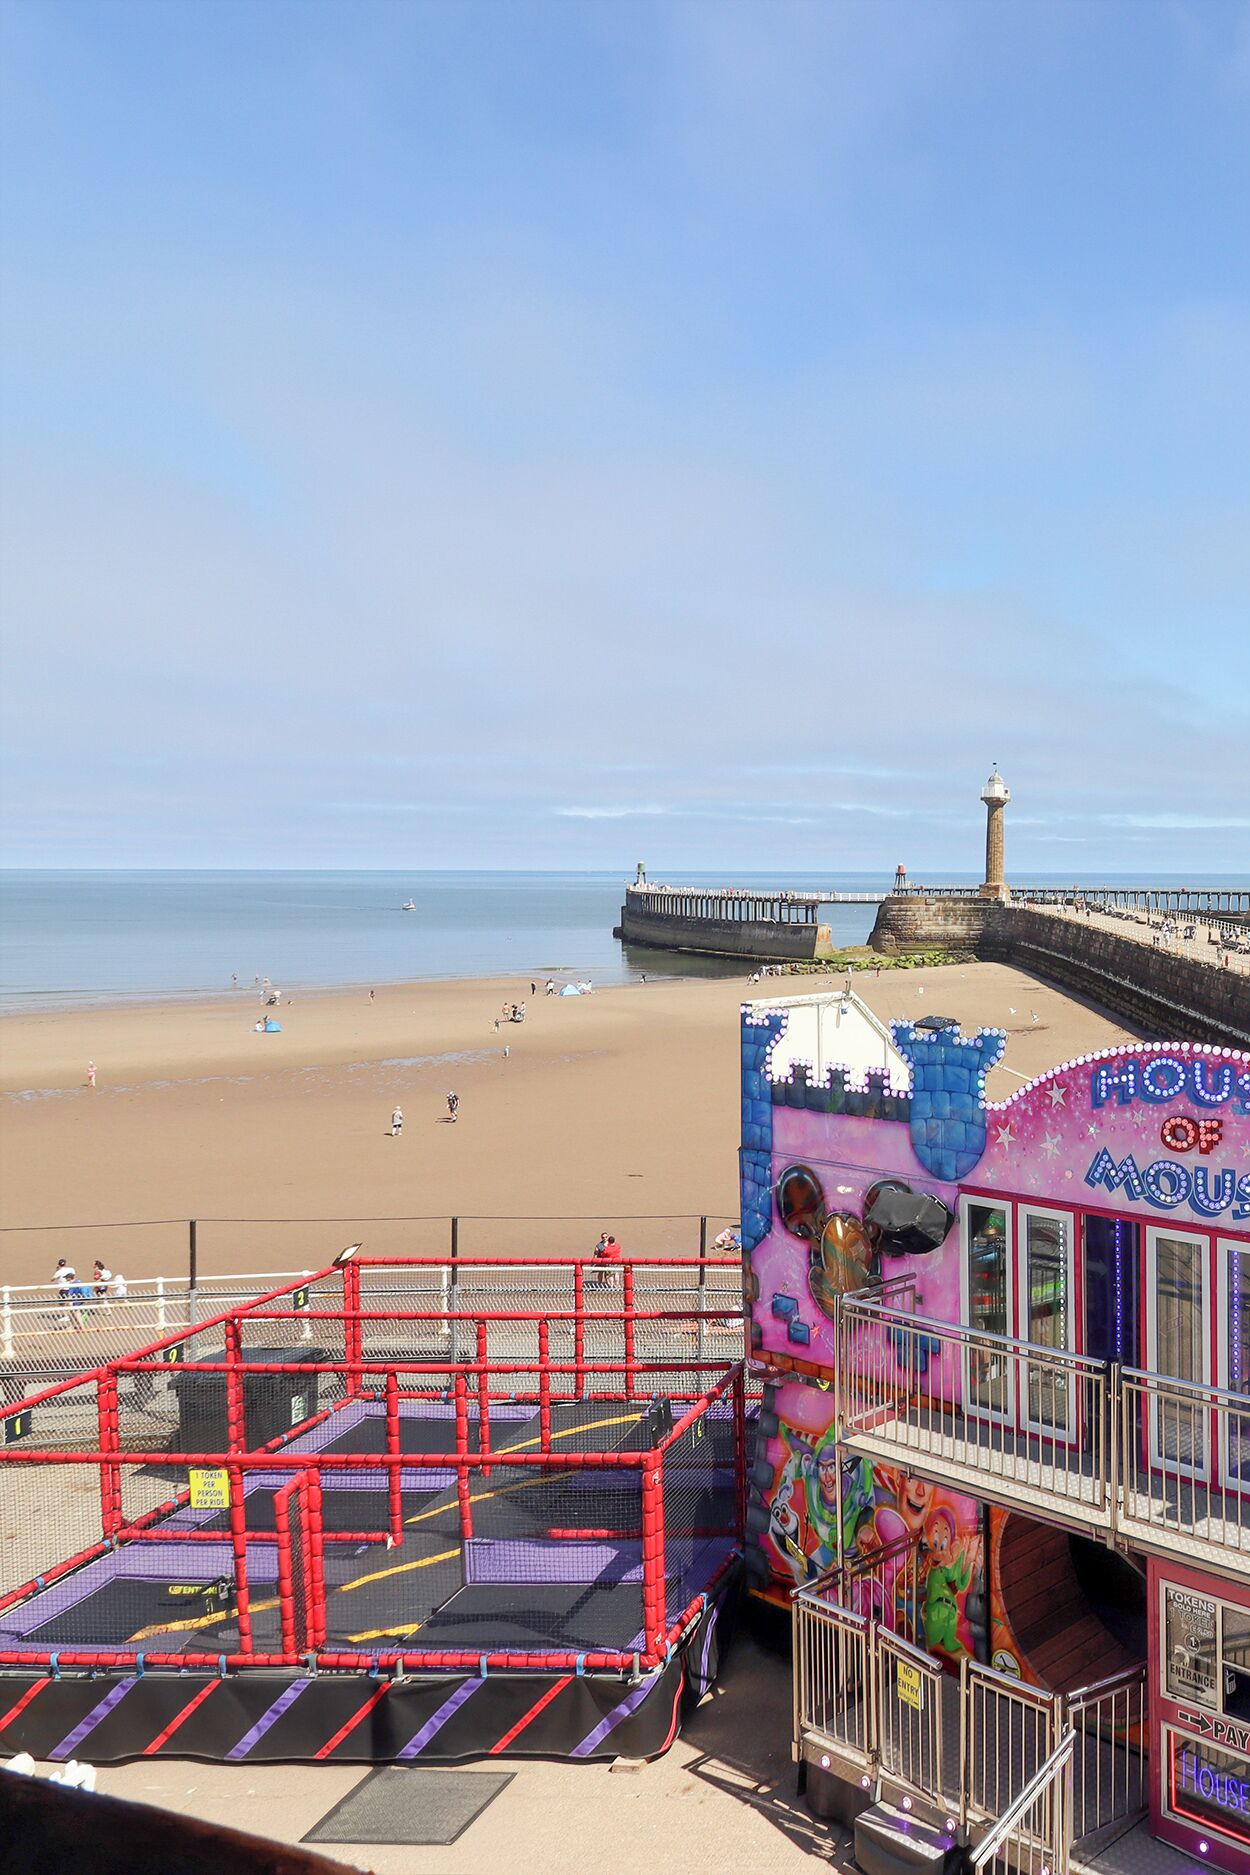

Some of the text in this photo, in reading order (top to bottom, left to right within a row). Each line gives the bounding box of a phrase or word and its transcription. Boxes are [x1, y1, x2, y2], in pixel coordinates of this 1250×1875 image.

[1160, 1116, 1223, 1155] OF
[15, 1417, 21, 1435] 1
[1168, 1589, 1216, 1614] TOKENS
[1173, 1601, 1211, 1619] SOLD HERE
[903, 1665, 913, 1678] NO
[1170, 1663, 1215, 1690] ENTRANCE
[898, 1677, 919, 1697] ENTRY
[1212, 1718, 1250, 1751] PAY
[1181, 1749, 1250, 1816] HOUSE
